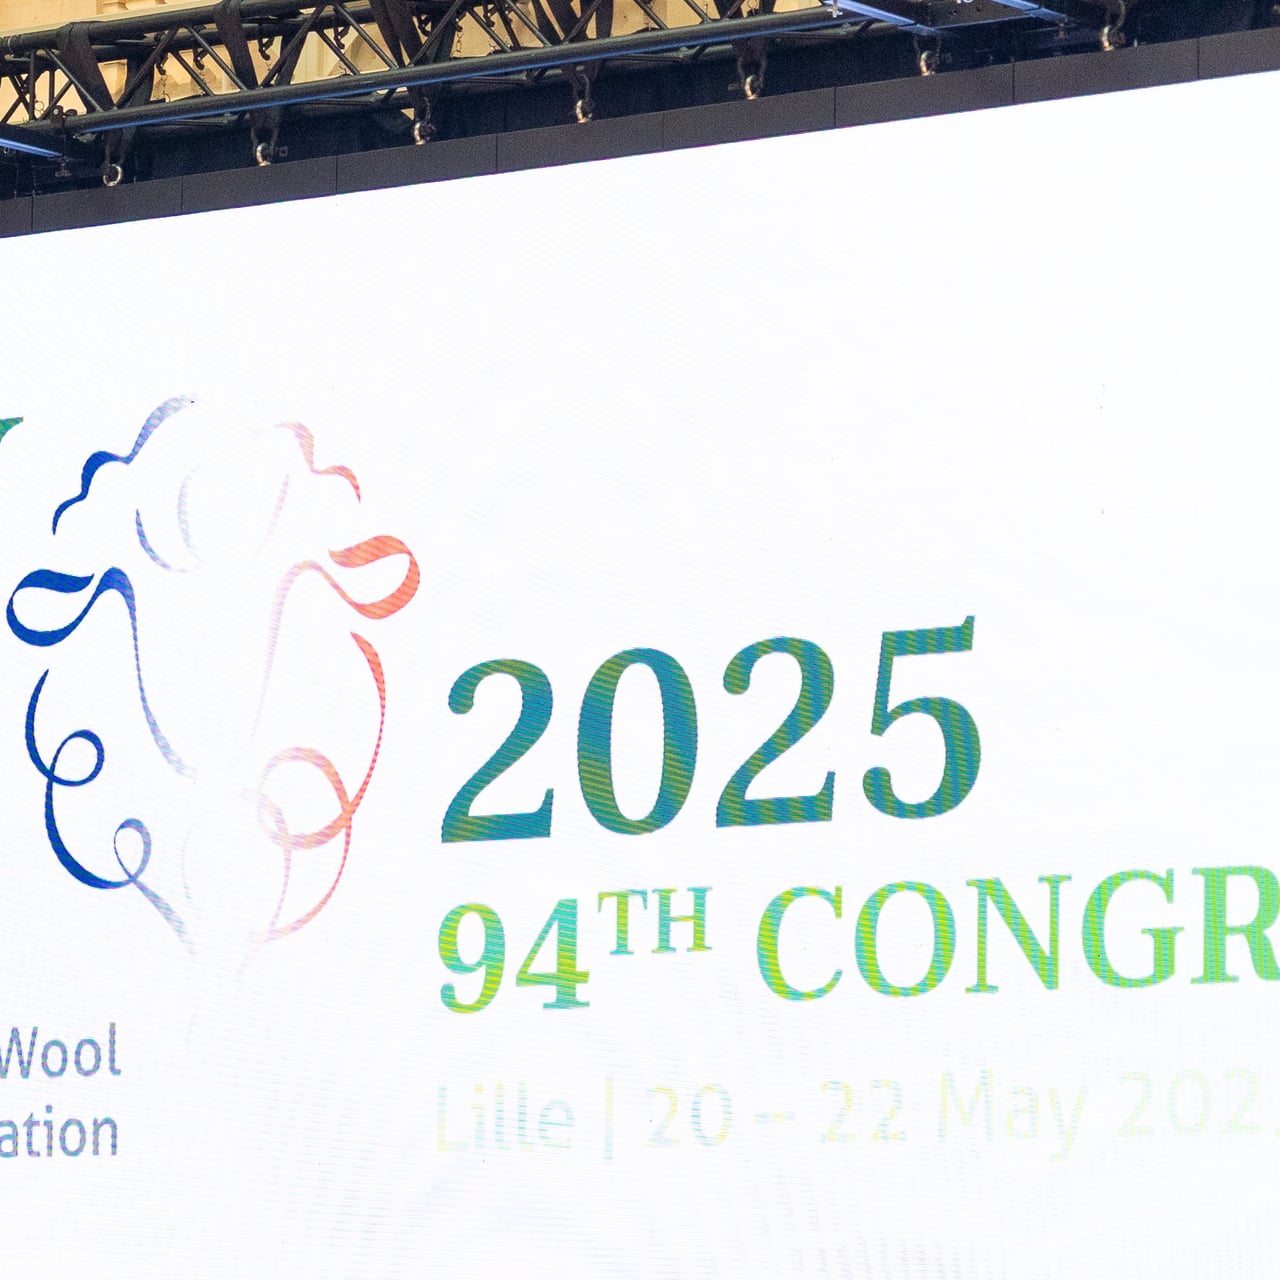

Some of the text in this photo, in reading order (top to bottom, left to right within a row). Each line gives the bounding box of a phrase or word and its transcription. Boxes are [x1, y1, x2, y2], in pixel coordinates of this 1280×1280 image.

[439, 614, 982, 844] 2025
[755, 864, 1280, 1003] CONGR
[435, 1080, 576, 1153] Lille
[646, 1082, 734, 1149] 20
[819, 1077, 907, 1145] 22
[936, 1067, 1088, 1162] May
